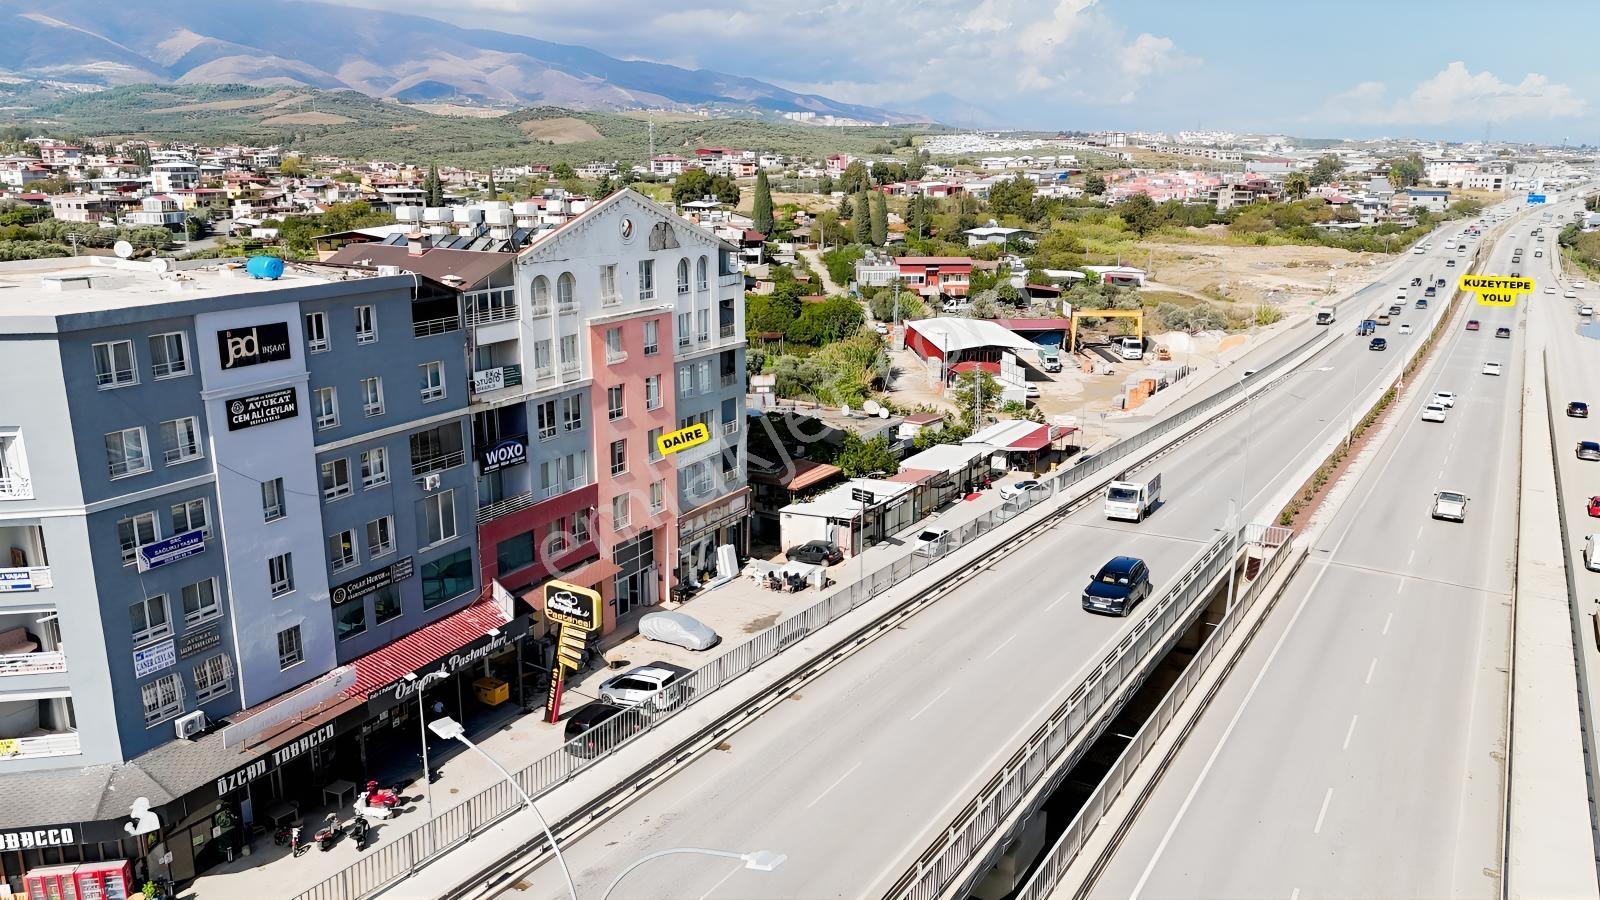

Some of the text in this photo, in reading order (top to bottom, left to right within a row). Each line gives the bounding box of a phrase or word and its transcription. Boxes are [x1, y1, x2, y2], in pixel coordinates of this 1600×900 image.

[226, 327, 259, 369] jad
[232, 412, 250, 424] CEM
[251, 408, 265, 420] ALİ
[265, 403, 295, 417] CEYLAN
[248, 395, 291, 410] AVUKAT
[486, 443, 523, 465] WOXO
[217, 723, 335, 797] ÖZCAN TOBACCO
